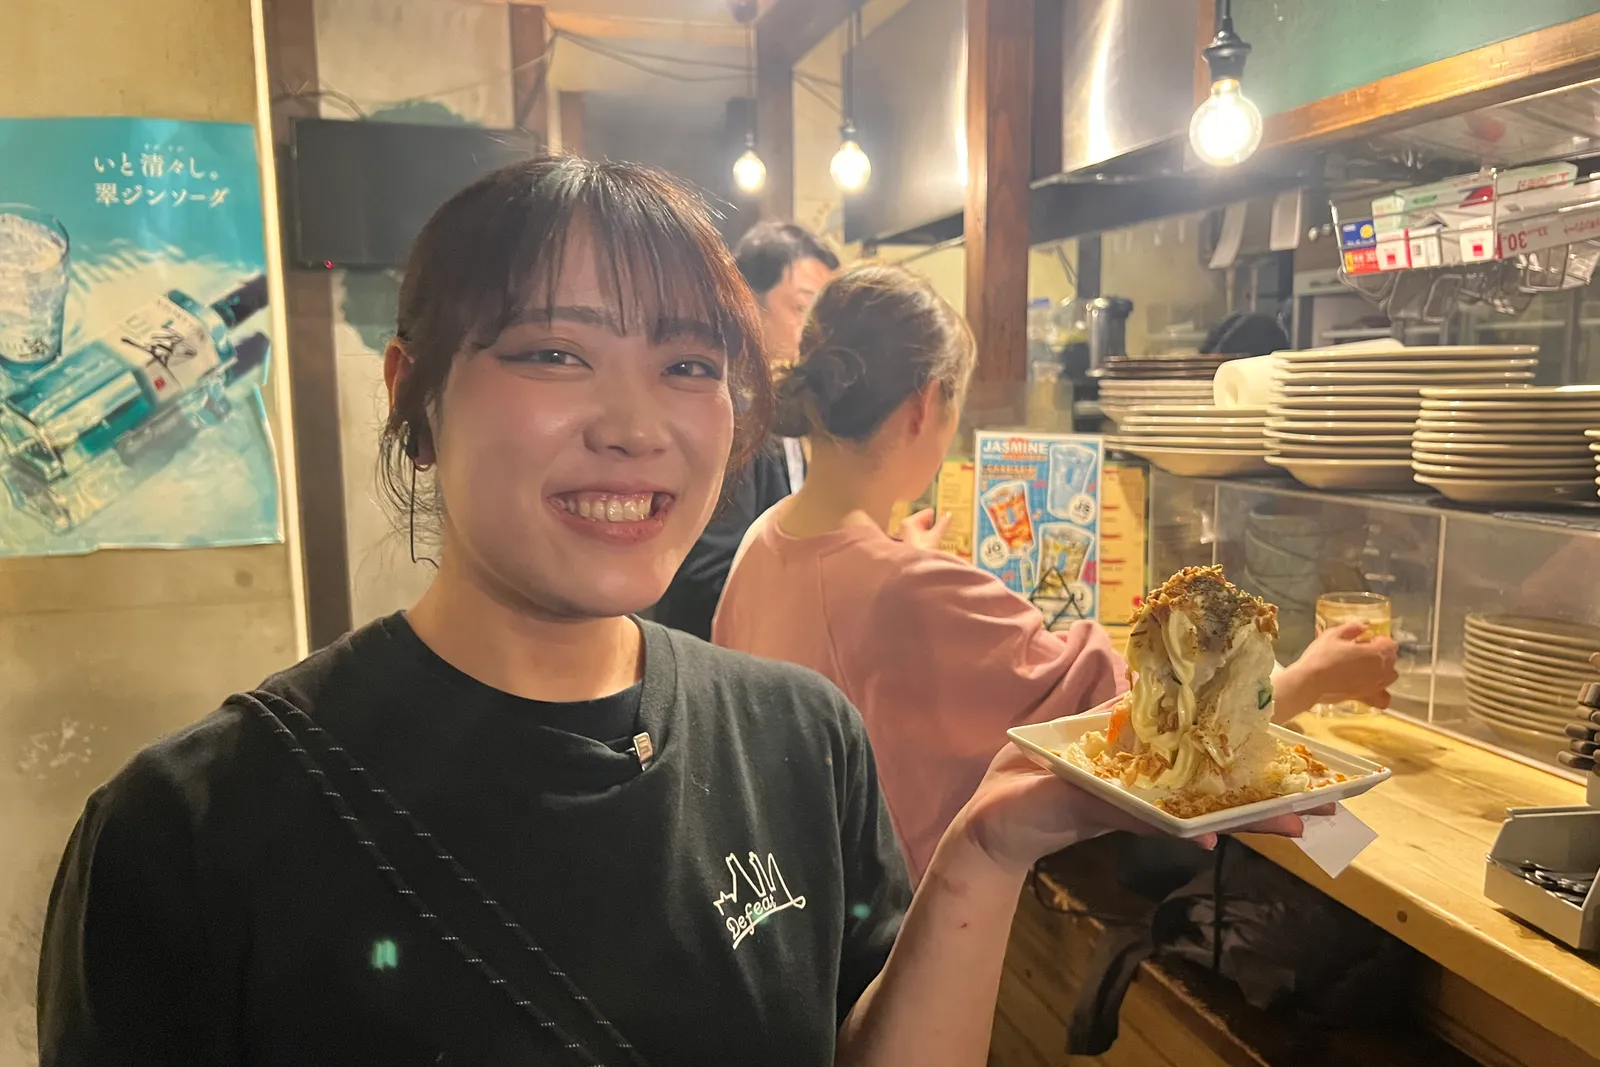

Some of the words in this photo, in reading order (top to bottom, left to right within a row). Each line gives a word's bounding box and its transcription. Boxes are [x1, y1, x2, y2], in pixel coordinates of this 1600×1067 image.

[93, 151, 219, 181] いと清々し。
[94, 182, 231, 208] 翠ジンソーダ
[983, 440, 1049, 455] JASMINE
[726, 893, 777, 940] Defeat
